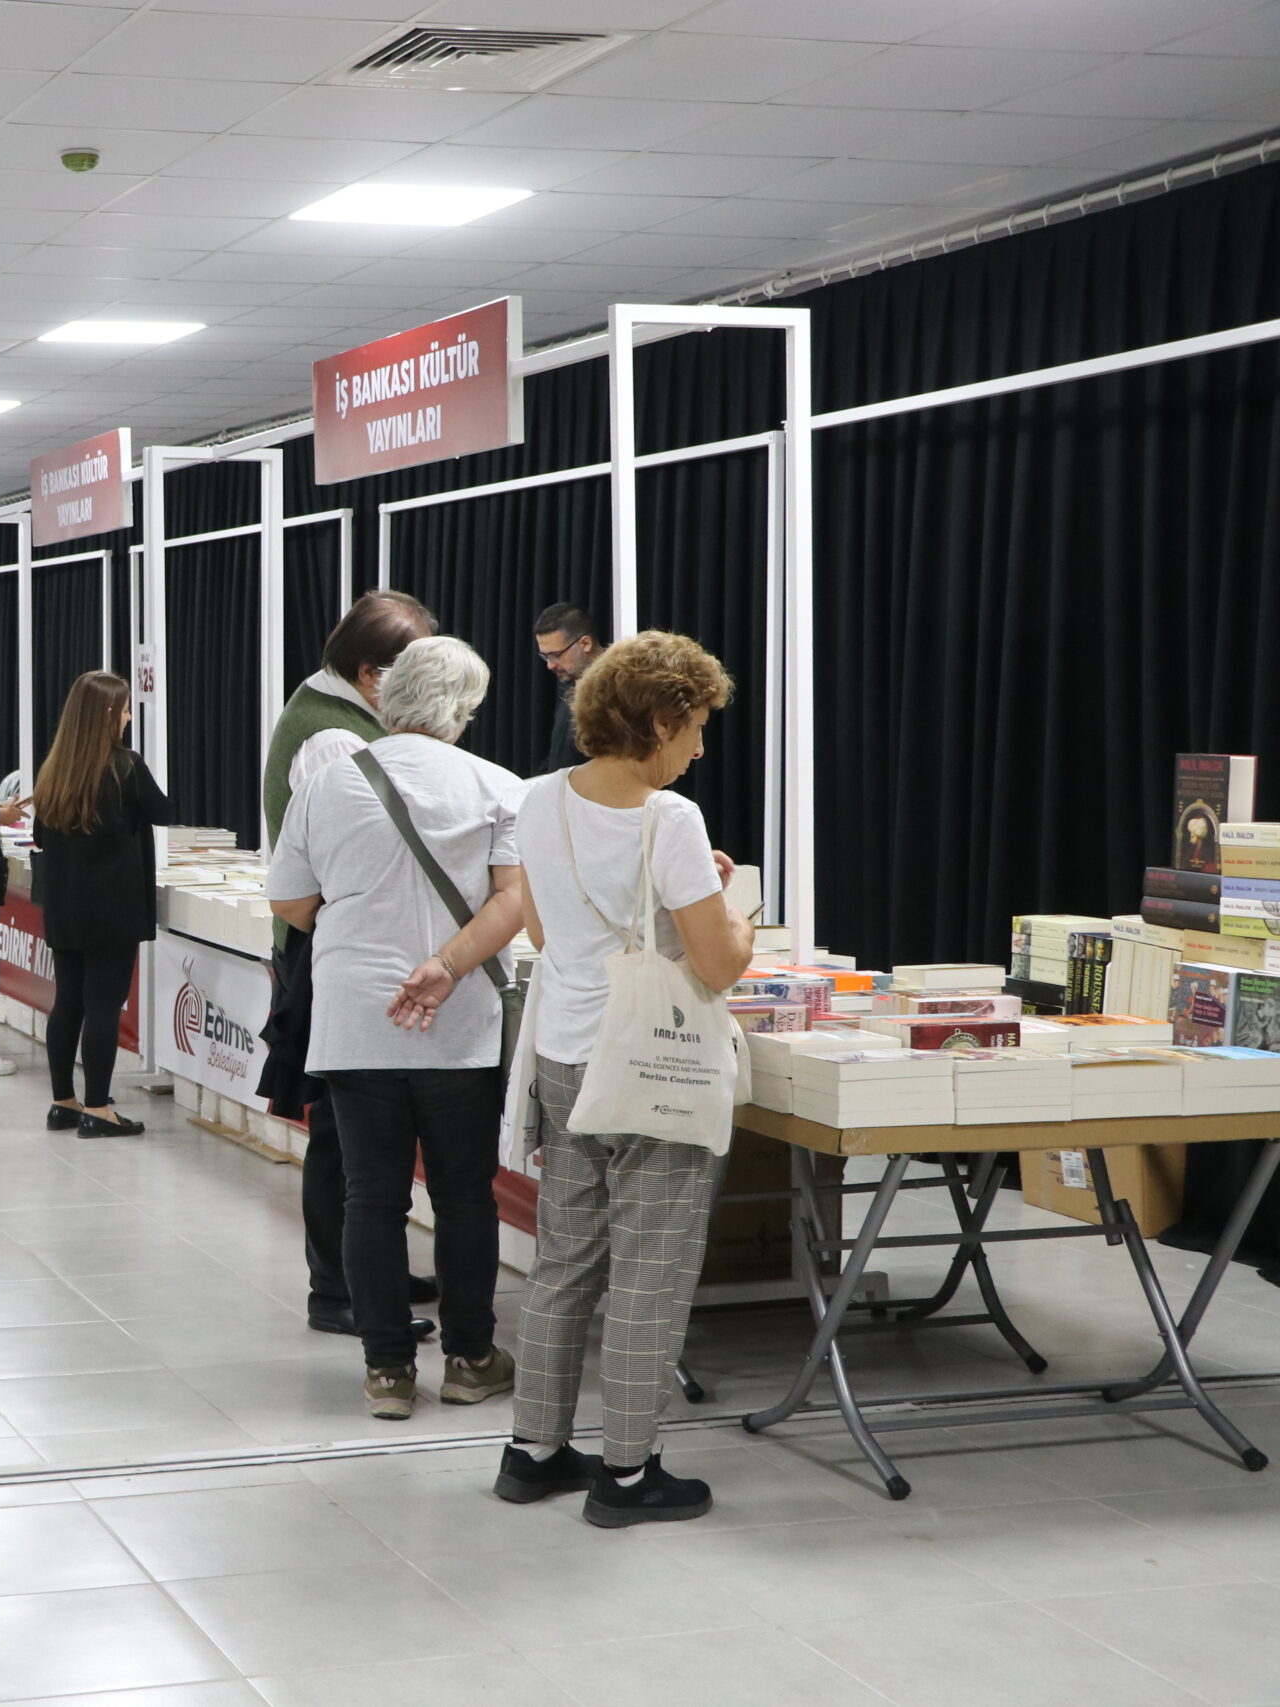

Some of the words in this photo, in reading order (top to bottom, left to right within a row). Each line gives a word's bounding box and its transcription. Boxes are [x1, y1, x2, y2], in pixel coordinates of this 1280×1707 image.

[336, 372, 348, 419] İŞ
[353, 358, 415, 409] BANKASI
[420, 333, 480, 390] KÜLTÜR
[366, 404, 442, 454] YAYINLARI
[49, 463, 80, 495] BANKASI
[81, 449, 109, 486] KÜLTÜR
[57, 496, 92, 528] YAYINLARI
[0, 916, 34, 972] EDİRNE
[204, 1000, 255, 1055] Edirne
[680, 1033, 701, 1044] 2018
[629, 1059, 651, 1069] SOCIAL
[639, 1071, 667, 1082] Berlin
[669, 1075, 711, 1086] Conference
